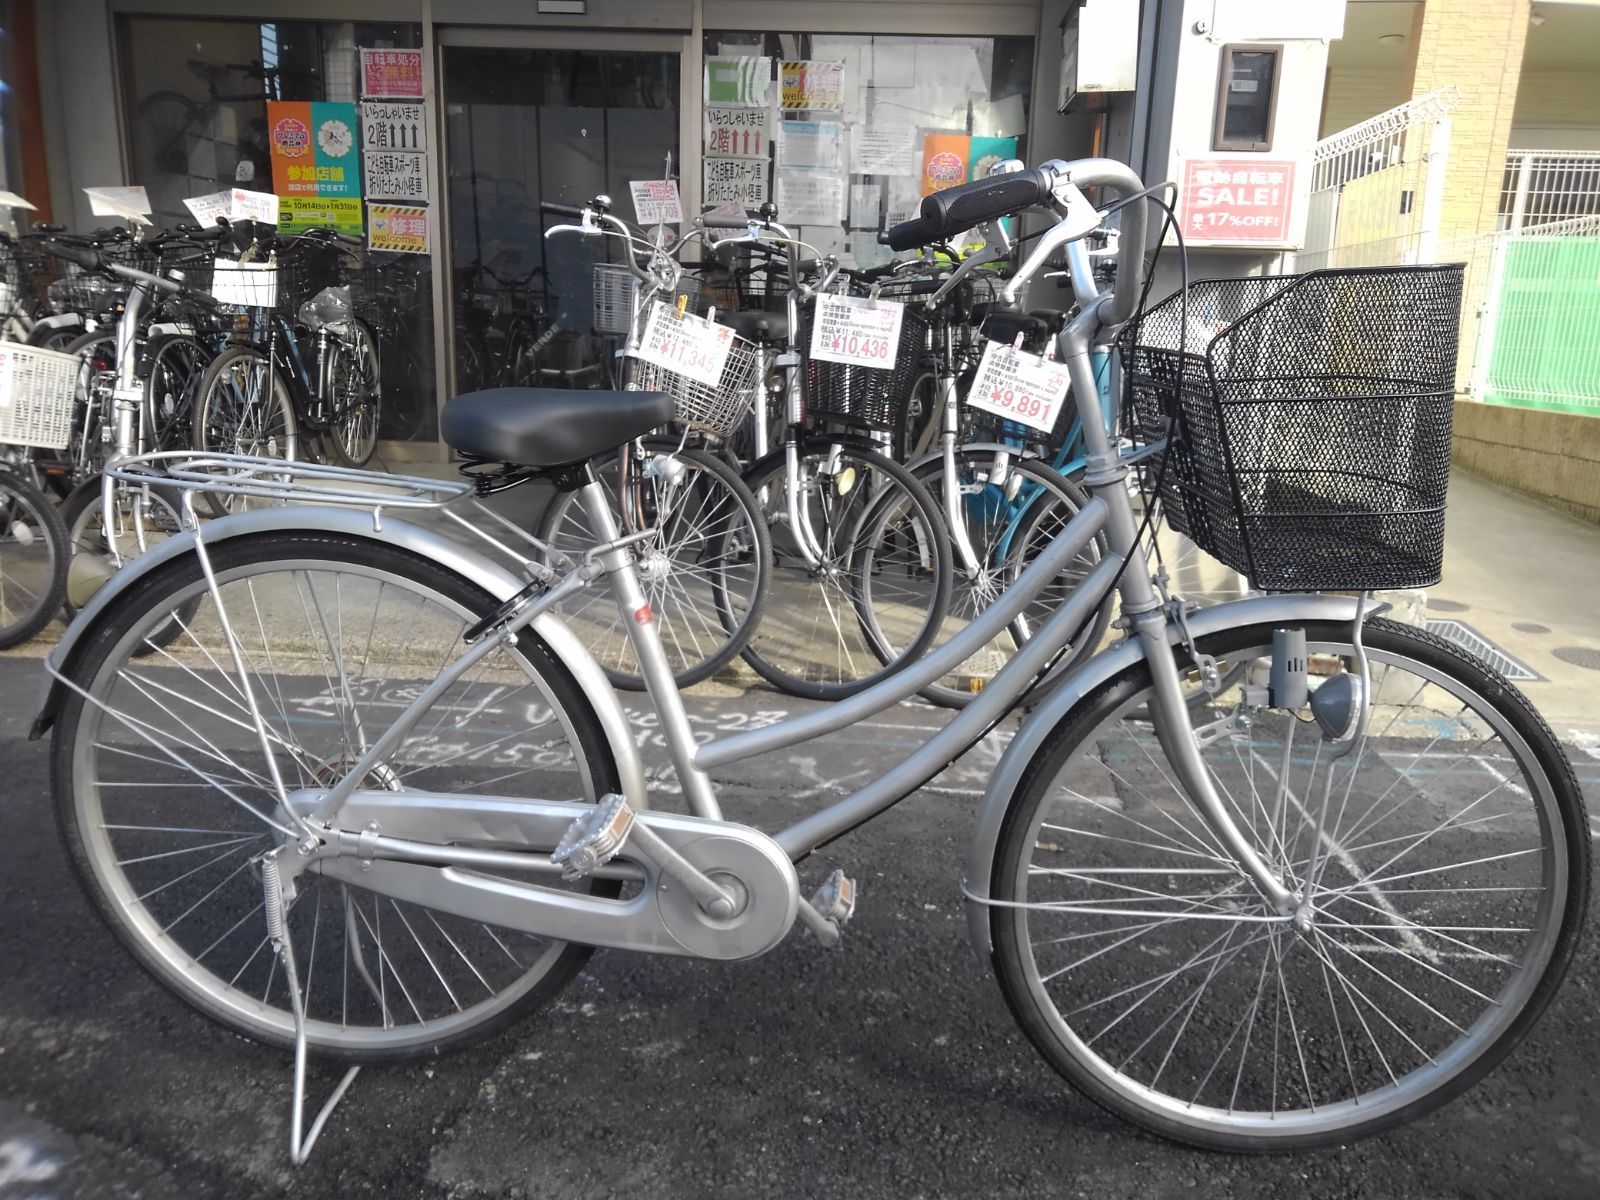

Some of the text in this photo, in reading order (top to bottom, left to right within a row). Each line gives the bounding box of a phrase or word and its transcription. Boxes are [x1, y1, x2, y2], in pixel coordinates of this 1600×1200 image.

[365, 53, 420, 65] 自転車処分
[365, 104, 419, 120] いらっしゃいませ
[708, 110, 765, 127] いらっしゃいませ
[368, 122, 388, 147] 2階
[709, 128, 730, 154] 2階
[287, 166, 344, 181] 参加店舗
[367, 155, 421, 175] こども自転車スポーツ車
[707, 161, 762, 182] こども自転車スポーツ車
[1195, 170, 1284, 185] 電動自転車
[1197, 187, 1280, 207] SALE!
[391, 217, 426, 236] 修理
[372, 232, 418, 244] welcome
[832, 331, 889, 359] ¥10,436
[990, 385, 1052, 421] ¥9,891
